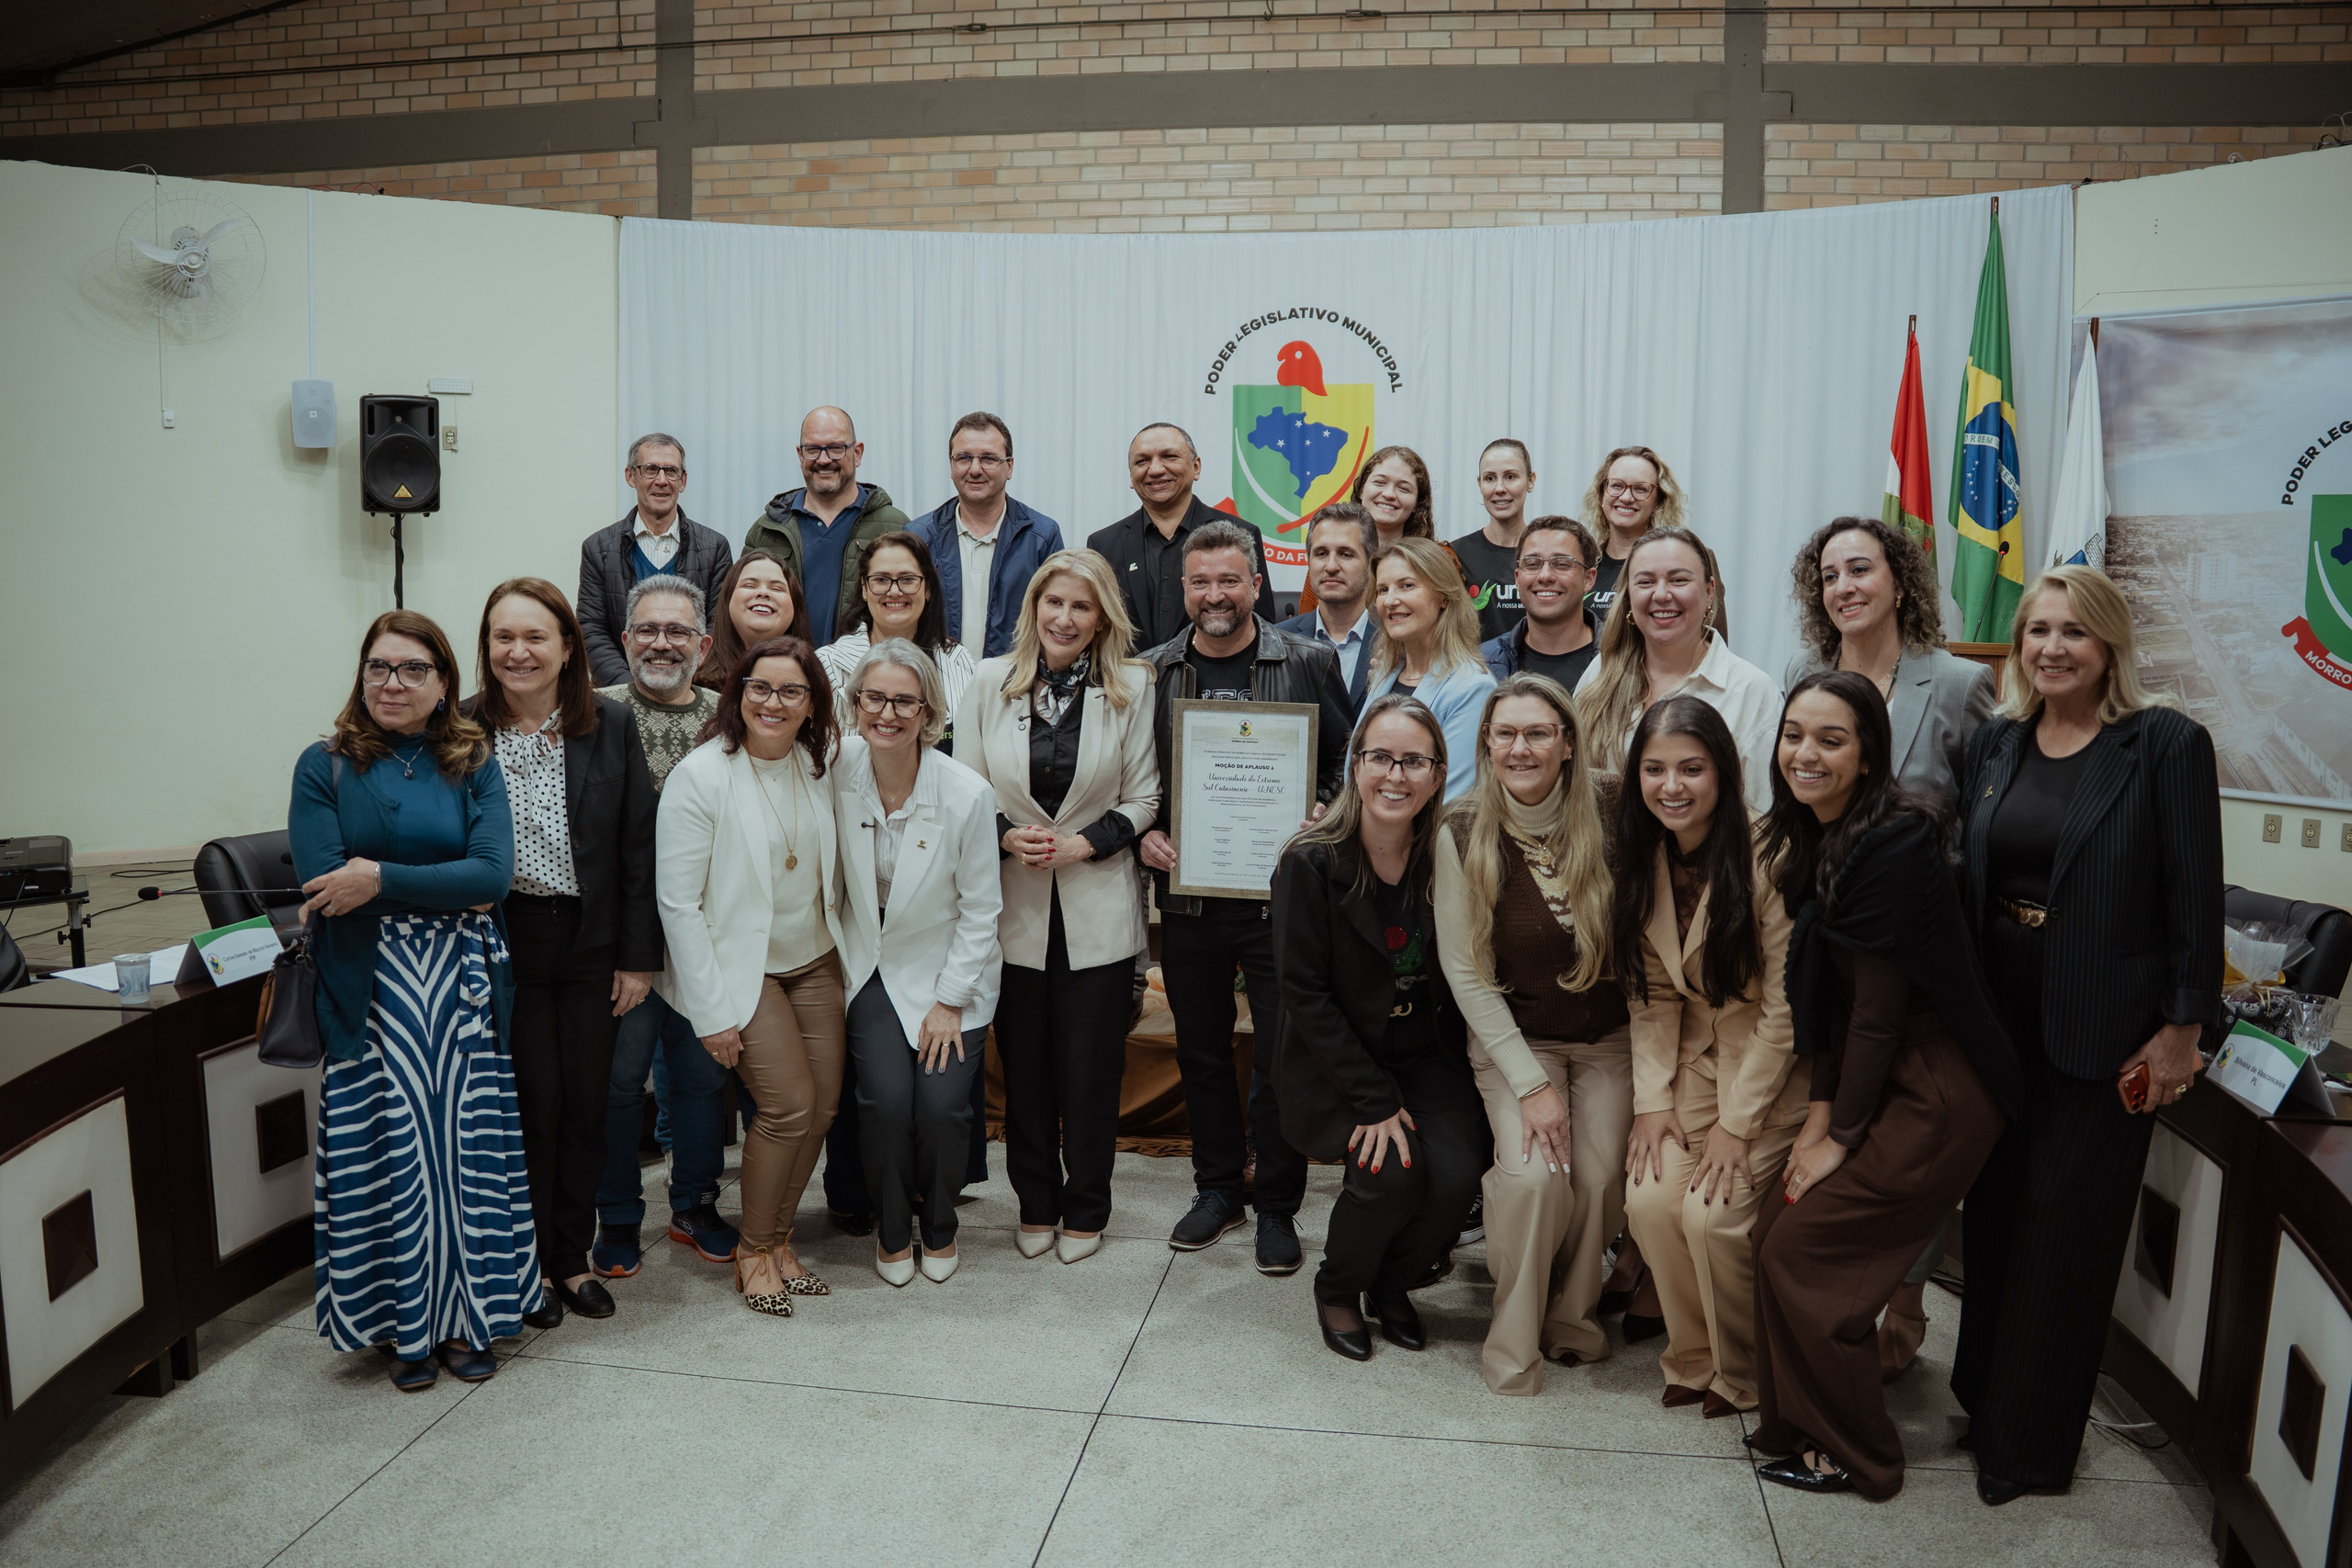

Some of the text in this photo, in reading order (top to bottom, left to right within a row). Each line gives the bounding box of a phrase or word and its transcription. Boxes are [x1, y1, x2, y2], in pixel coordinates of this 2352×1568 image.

[1204, 307, 1403, 395] PODER LEGISLATIVO MUNICIPAL
[2281, 446, 2321, 505] PODER
[1276, 550, 1295, 561] DA
[2304, 649, 2352, 684] MORRO
[1203, 783, 1214, 792] Sul
[1214, 784, 1249, 792] Catarinense
[1257, 785, 1286, 794] UNESC
[1207, 773, 1247, 782] Universidade
[1257, 774, 1281, 784] Extremo
[2233, 1056, 2287, 1089] Silvana de Vasconcelos
[2250, 1077, 2257, 1086] PL
